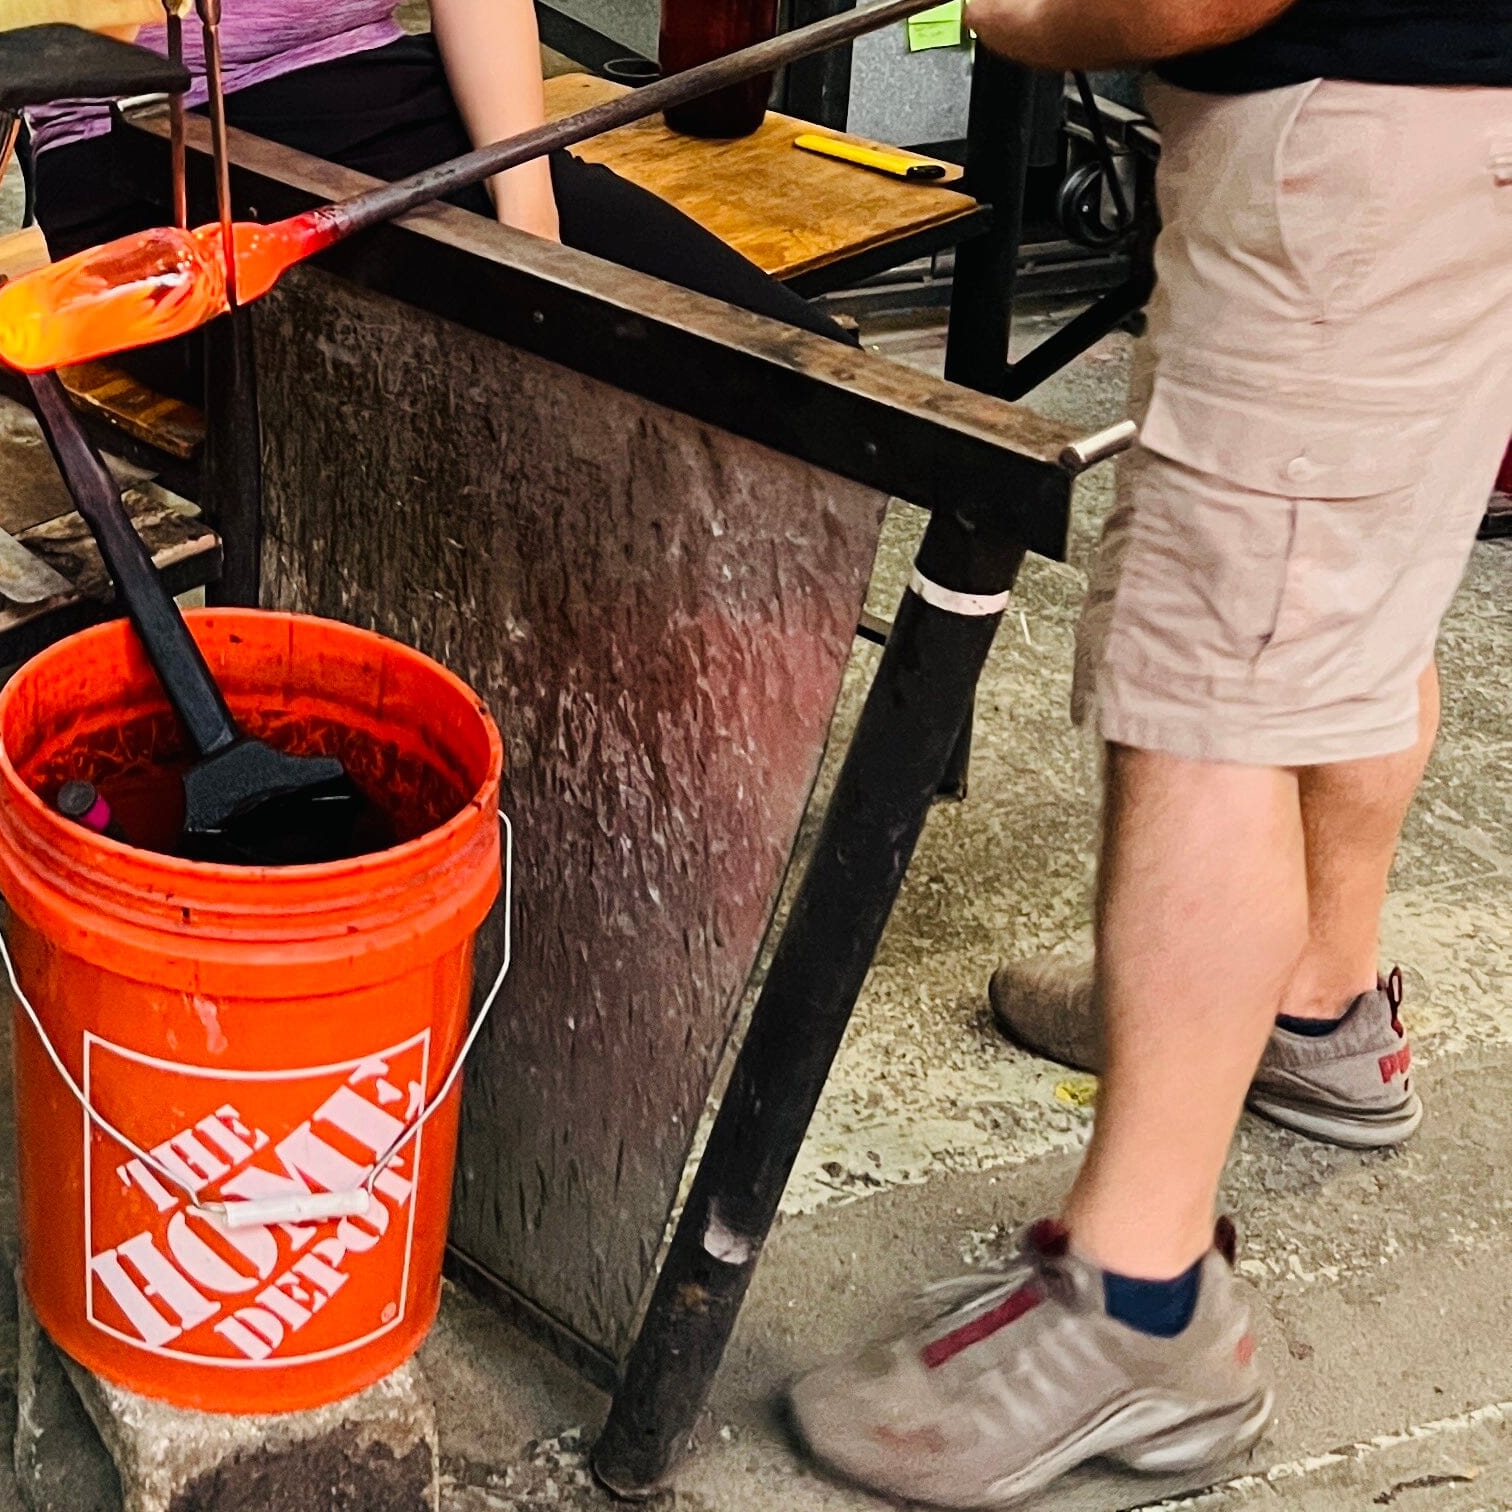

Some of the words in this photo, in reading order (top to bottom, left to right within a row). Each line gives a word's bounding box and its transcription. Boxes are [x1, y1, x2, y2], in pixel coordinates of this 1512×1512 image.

[90, 1057, 423, 1348] HOME
[116, 1103, 270, 1213] THE
[213, 1155, 414, 1361] DEPOT
